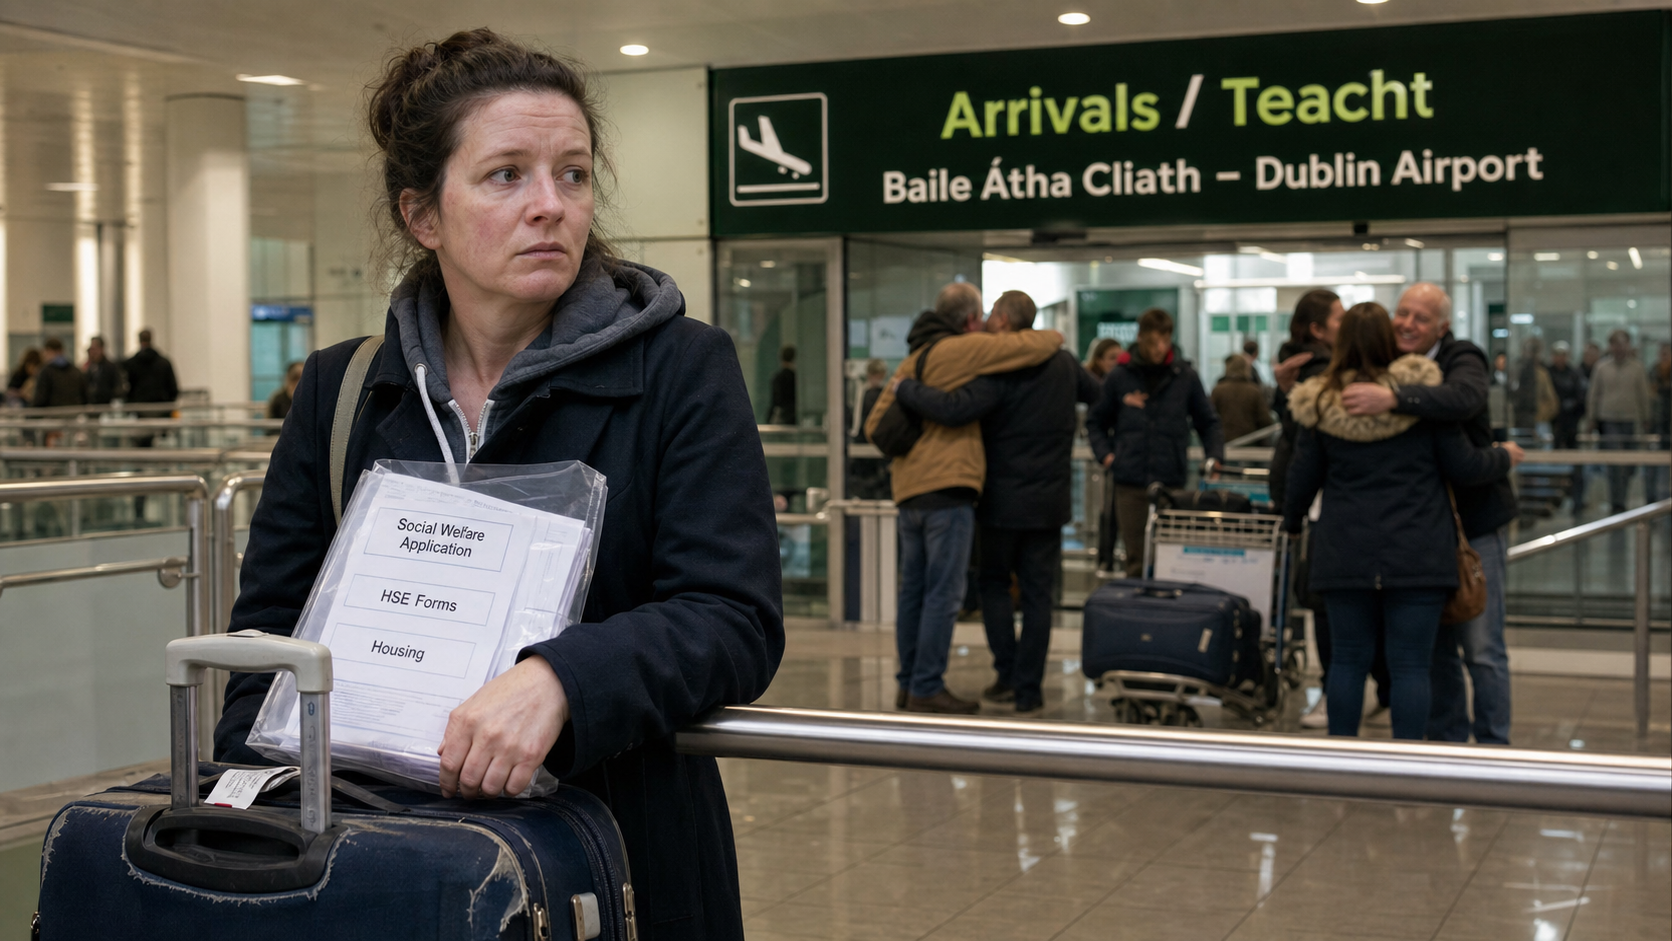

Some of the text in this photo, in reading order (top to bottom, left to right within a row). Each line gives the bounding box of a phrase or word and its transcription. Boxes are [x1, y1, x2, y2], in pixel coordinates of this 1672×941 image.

[940, 68, 1434, 139] Arrivals / Teacht
[883, 168, 972, 204] Baile
[980, 156, 1072, 200] Átha
[1082, 158, 1201, 197] Cliath
[1255, 152, 1381, 190] Dublin
[1391, 147, 1544, 192] Airport
[397, 517, 485, 542] Social Welfare
[399, 536, 472, 558] Application
[380, 589, 457, 612] HSE Forms
[371, 640, 425, 663] Housing
